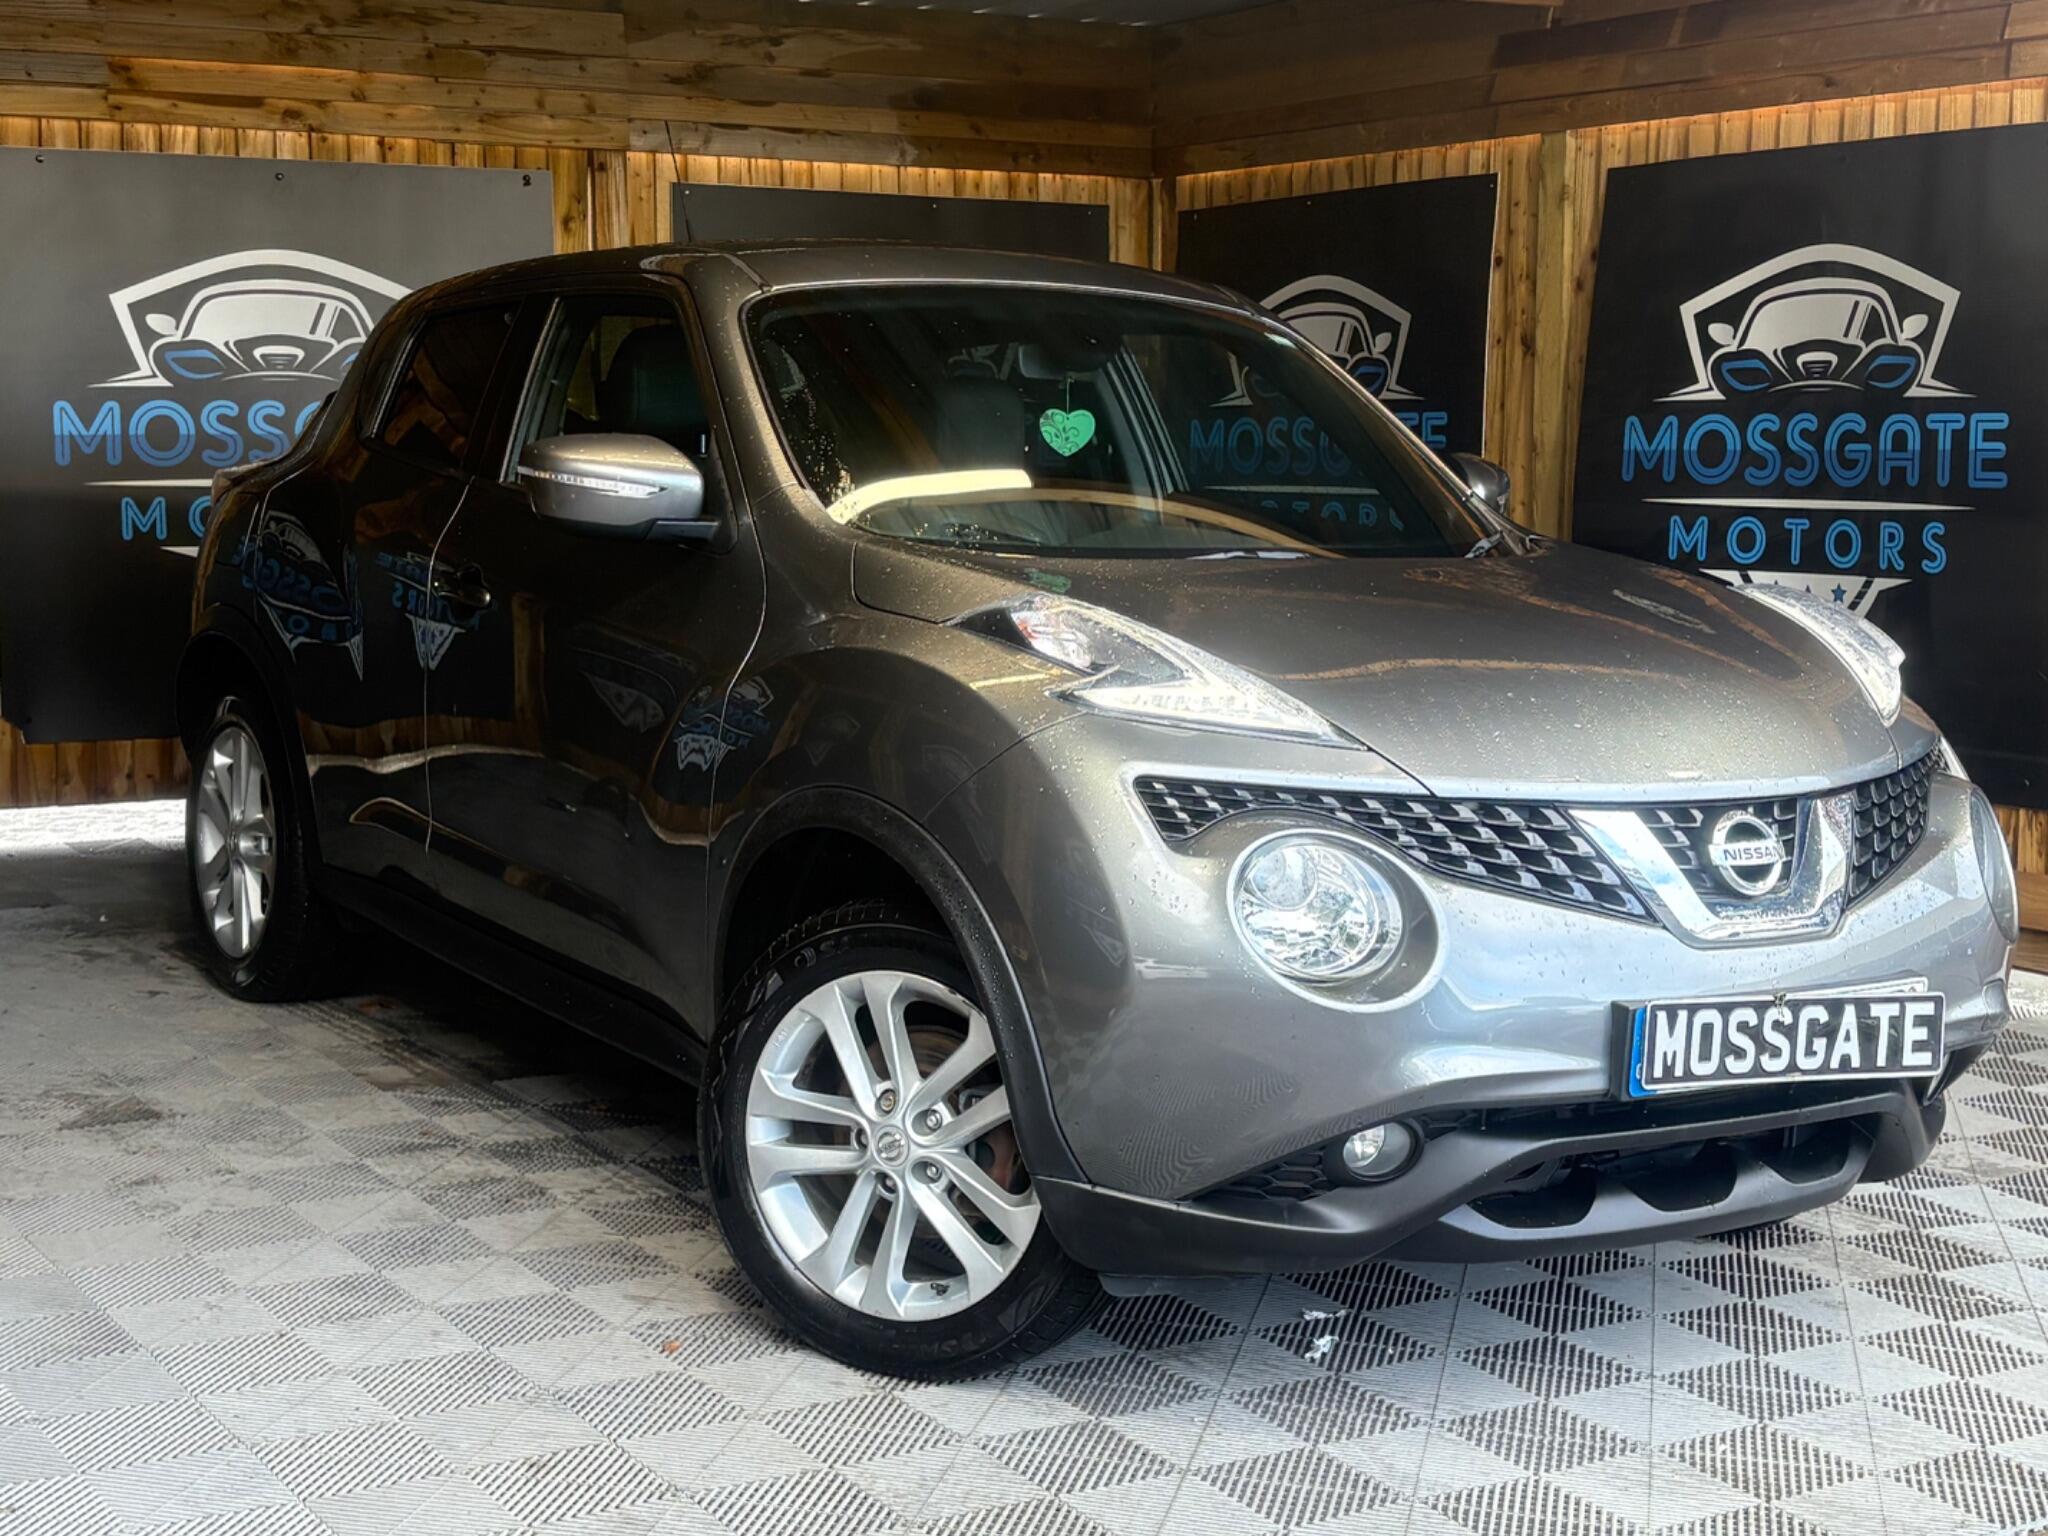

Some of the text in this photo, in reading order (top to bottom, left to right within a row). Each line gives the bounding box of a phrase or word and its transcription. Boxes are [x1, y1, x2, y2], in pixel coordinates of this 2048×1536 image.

[1621, 412, 2009, 488] MOSSGATE
[1668, 515, 1947, 574] MOTORS
[1723, 846, 1783, 861] NISSAN
[1653, 1001, 1936, 1079] MOSSGATE
